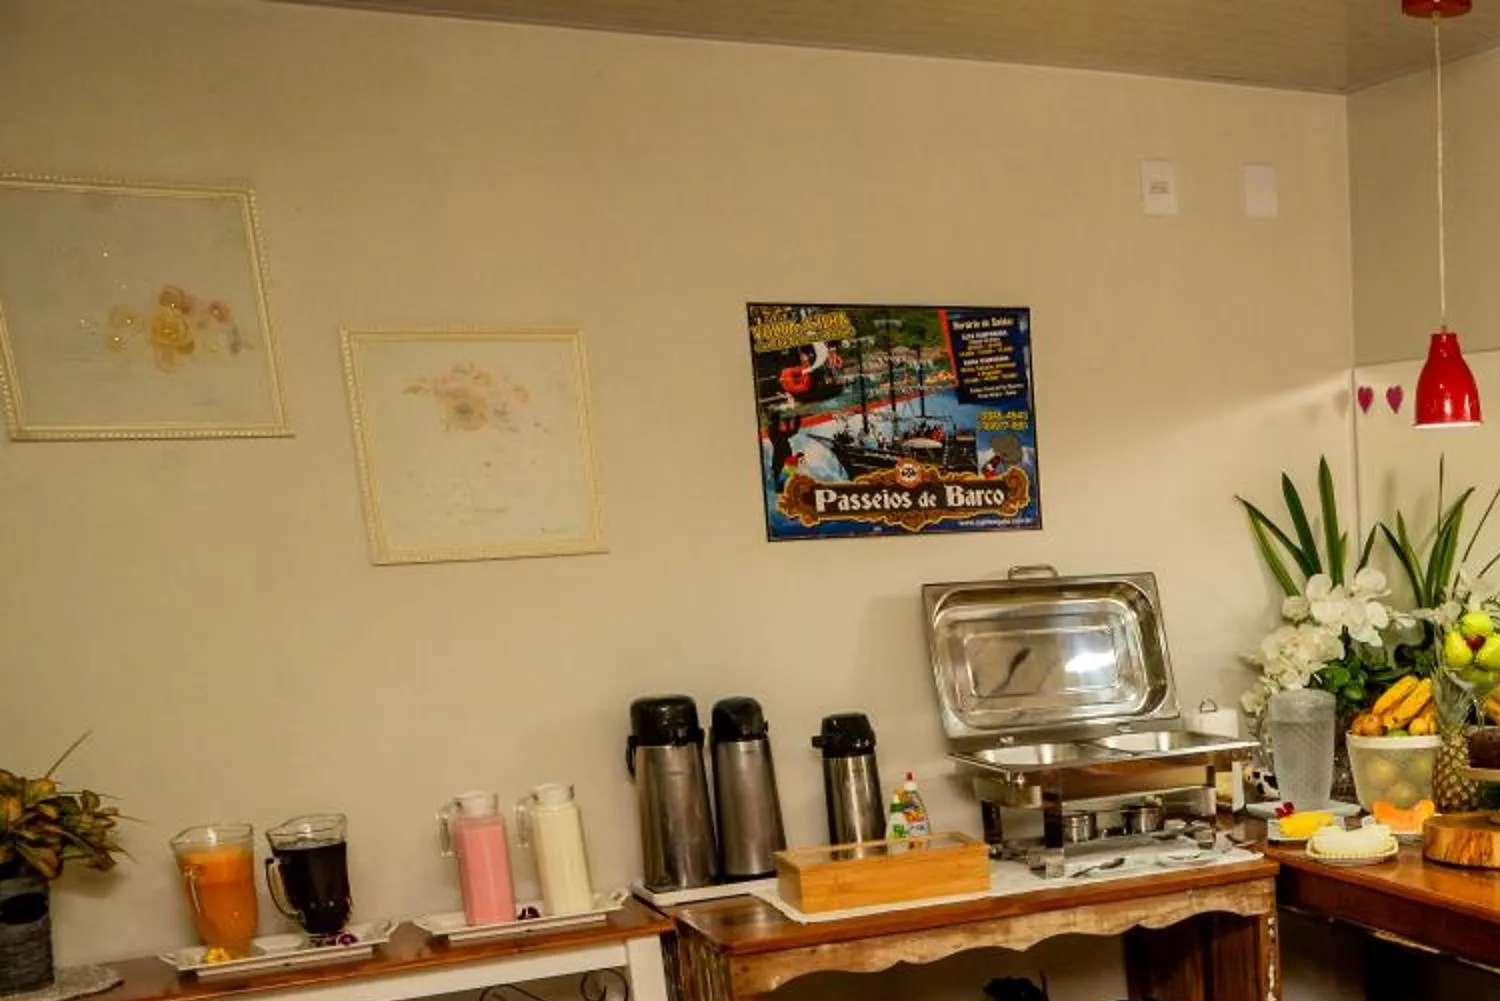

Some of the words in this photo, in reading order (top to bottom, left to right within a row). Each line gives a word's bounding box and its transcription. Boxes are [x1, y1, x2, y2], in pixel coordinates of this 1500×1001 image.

[814, 487, 912, 513] Passeios
[918, 491, 937, 508] de
[944, 484, 1005, 508] Barco
